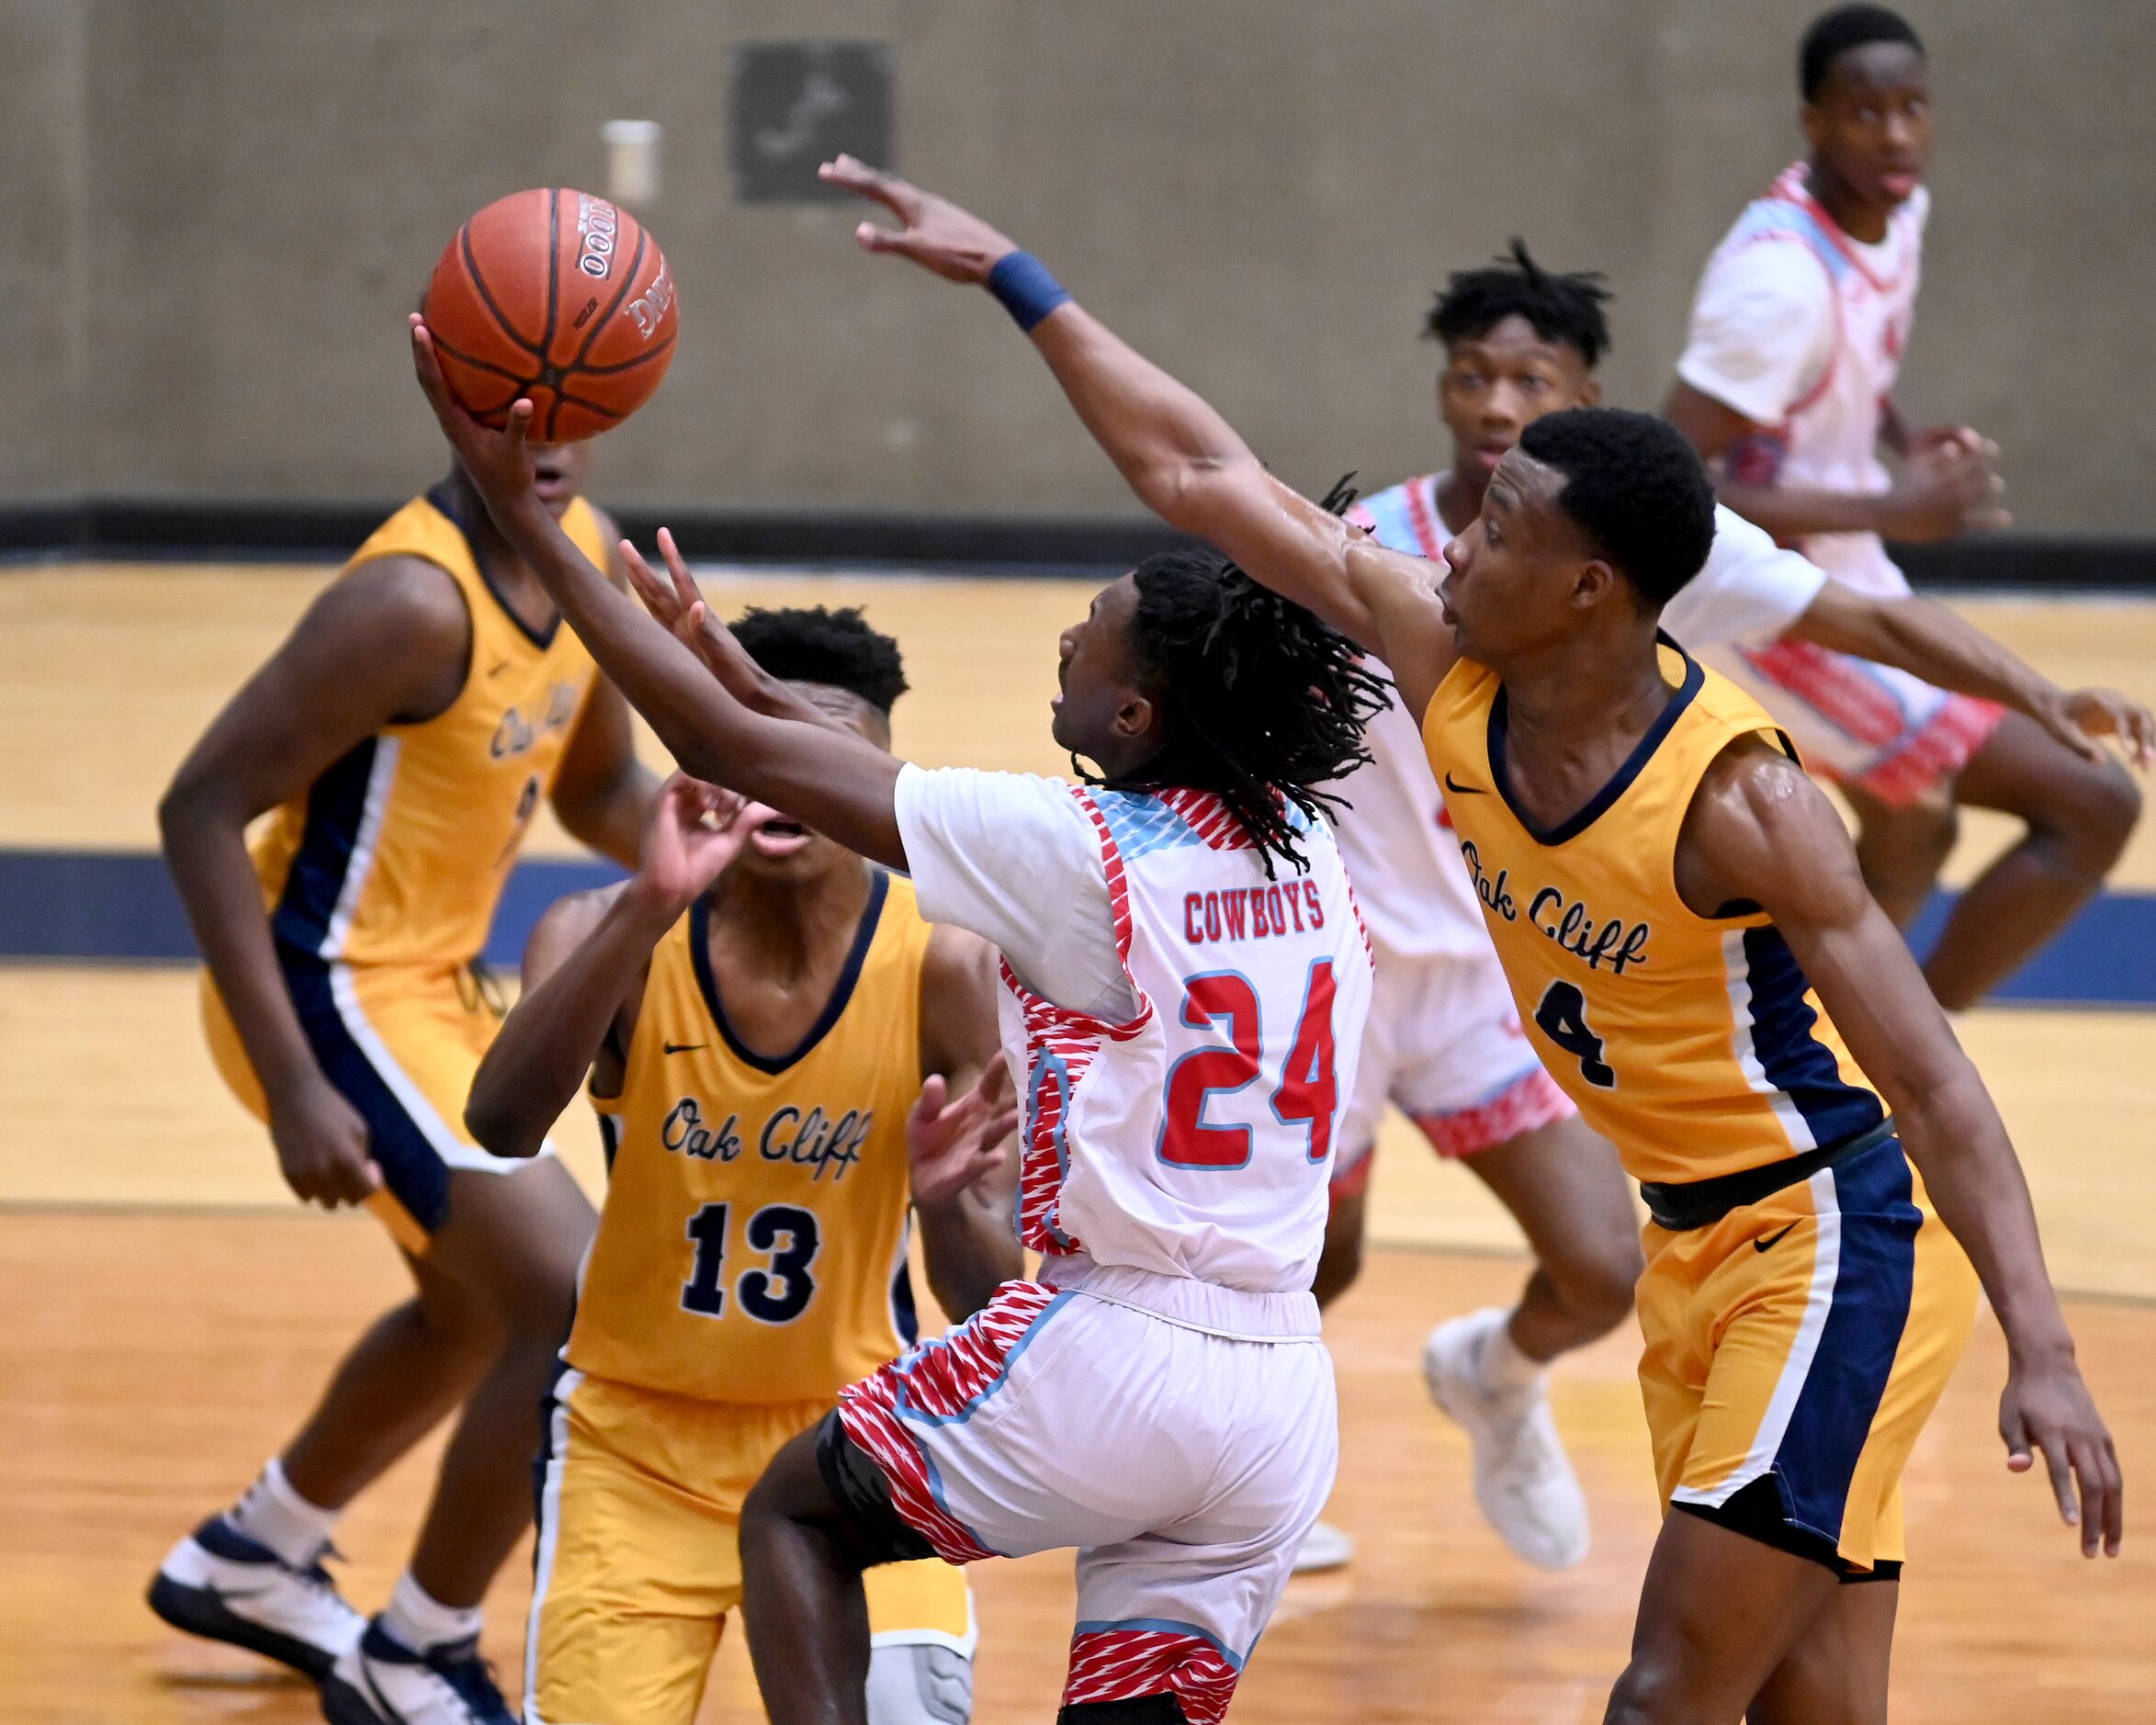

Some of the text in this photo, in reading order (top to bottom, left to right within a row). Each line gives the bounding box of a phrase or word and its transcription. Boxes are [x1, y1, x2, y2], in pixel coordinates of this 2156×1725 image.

[1182, 878, 1325, 945] COWBOYS
[1529, 886, 1650, 975] Cliff
[1155, 955, 1339, 1171] 24
[1533, 977, 1617, 1089] 4
[660, 1097, 874, 1183] Oak Cliff
[679, 1201, 823, 1325] 13
